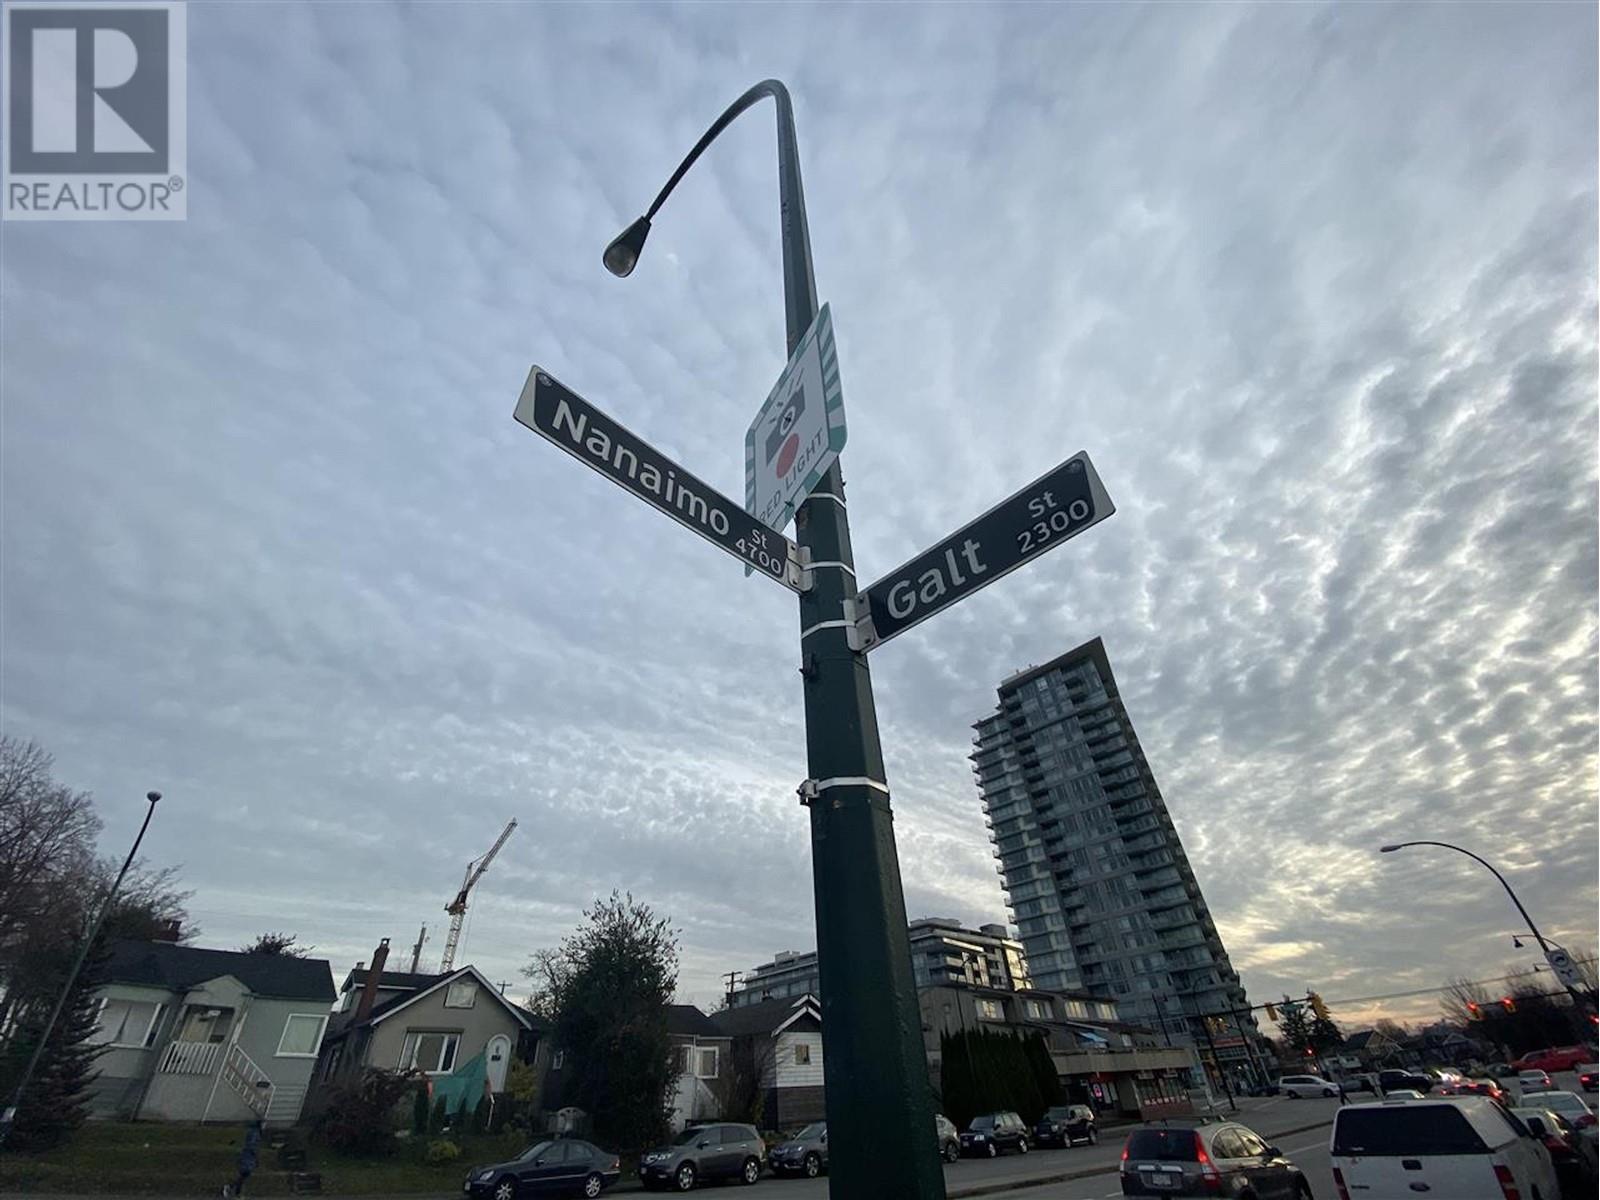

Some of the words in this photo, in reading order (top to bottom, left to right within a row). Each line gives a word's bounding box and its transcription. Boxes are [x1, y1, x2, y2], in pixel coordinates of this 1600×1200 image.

[552, 399, 730, 536] Nanaimo
[760, 489, 781, 522] RED
[785, 427, 824, 491] LIGHT
[1017, 499, 1090, 554] 2300
[1028, 490, 1058, 519] St
[735, 538, 782, 576] 4700
[751, 528, 769, 549] St
[887, 539, 988, 620] Galt
